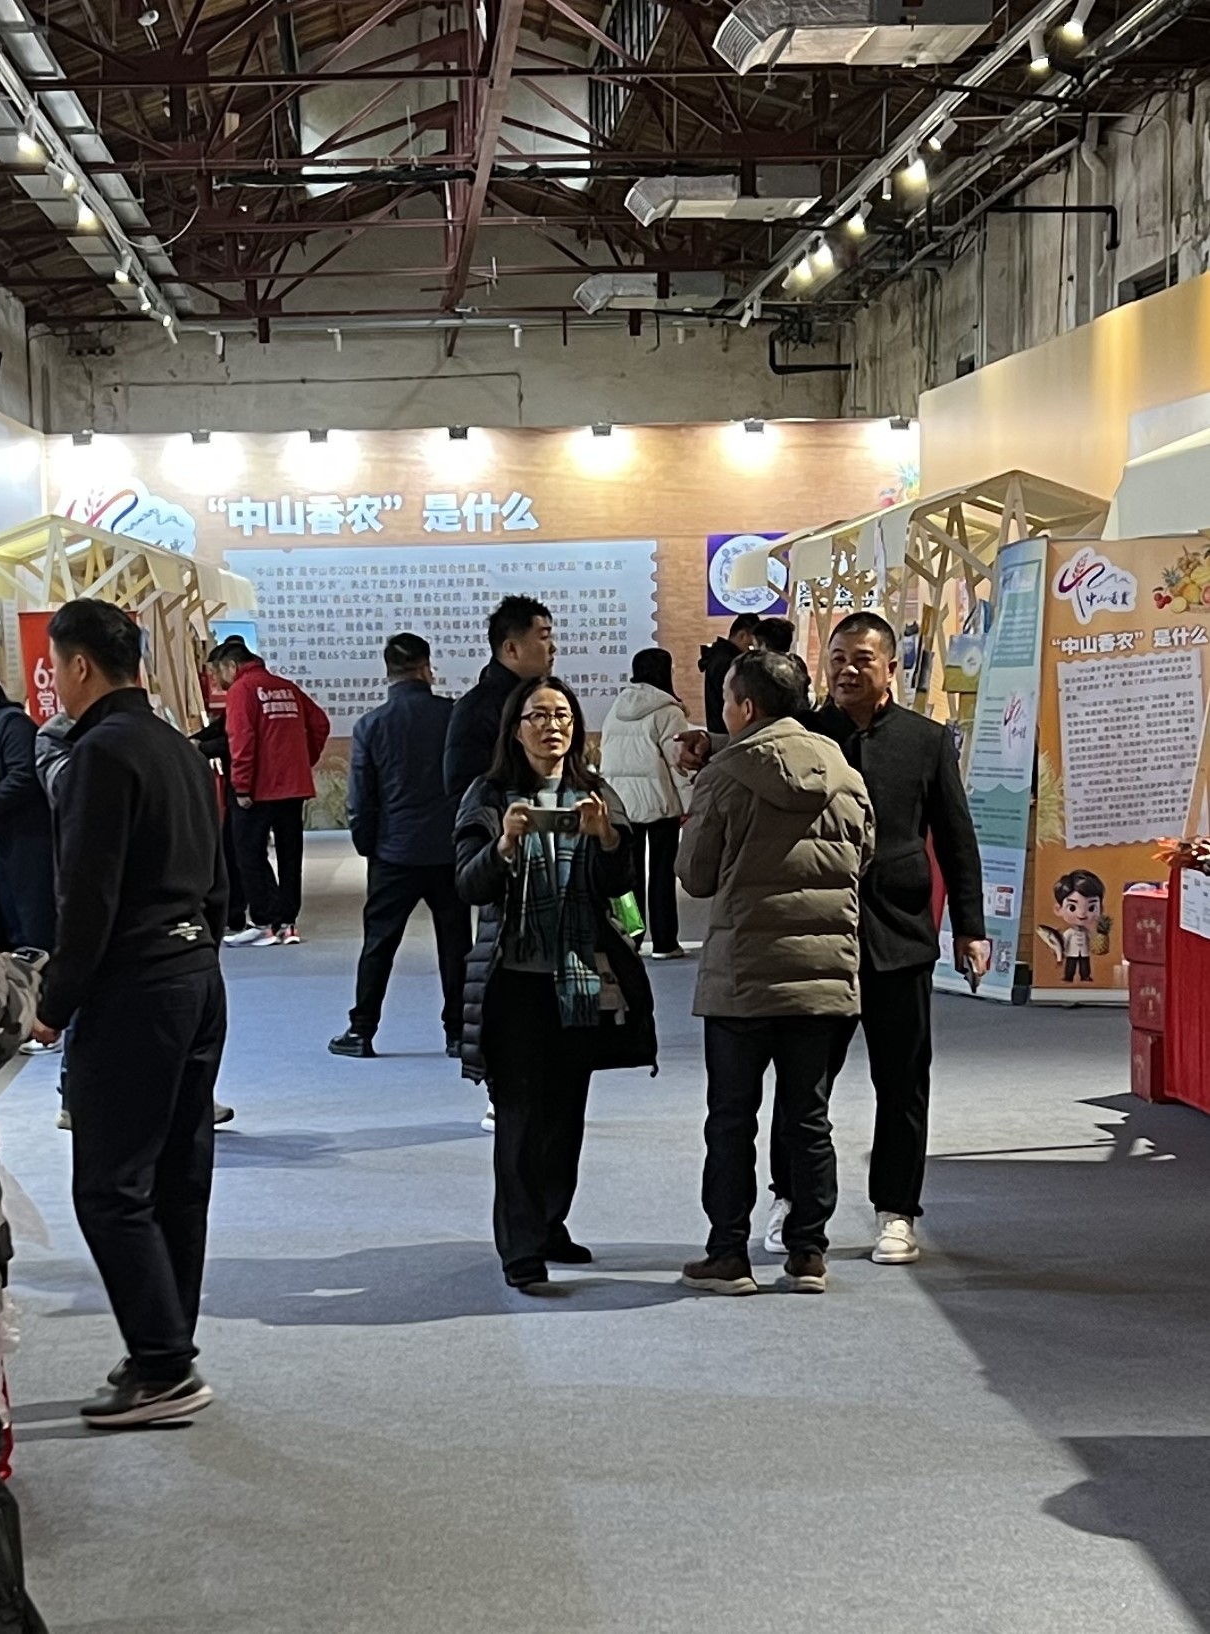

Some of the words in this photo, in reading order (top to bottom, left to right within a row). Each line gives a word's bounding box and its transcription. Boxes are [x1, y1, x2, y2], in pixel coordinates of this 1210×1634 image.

[208, 493, 402, 537] “中山香农”
[423, 491, 540, 533] 是什么
[1051, 631, 1143, 655] “中山香农”
[1153, 625, 1209, 648] 是什么
